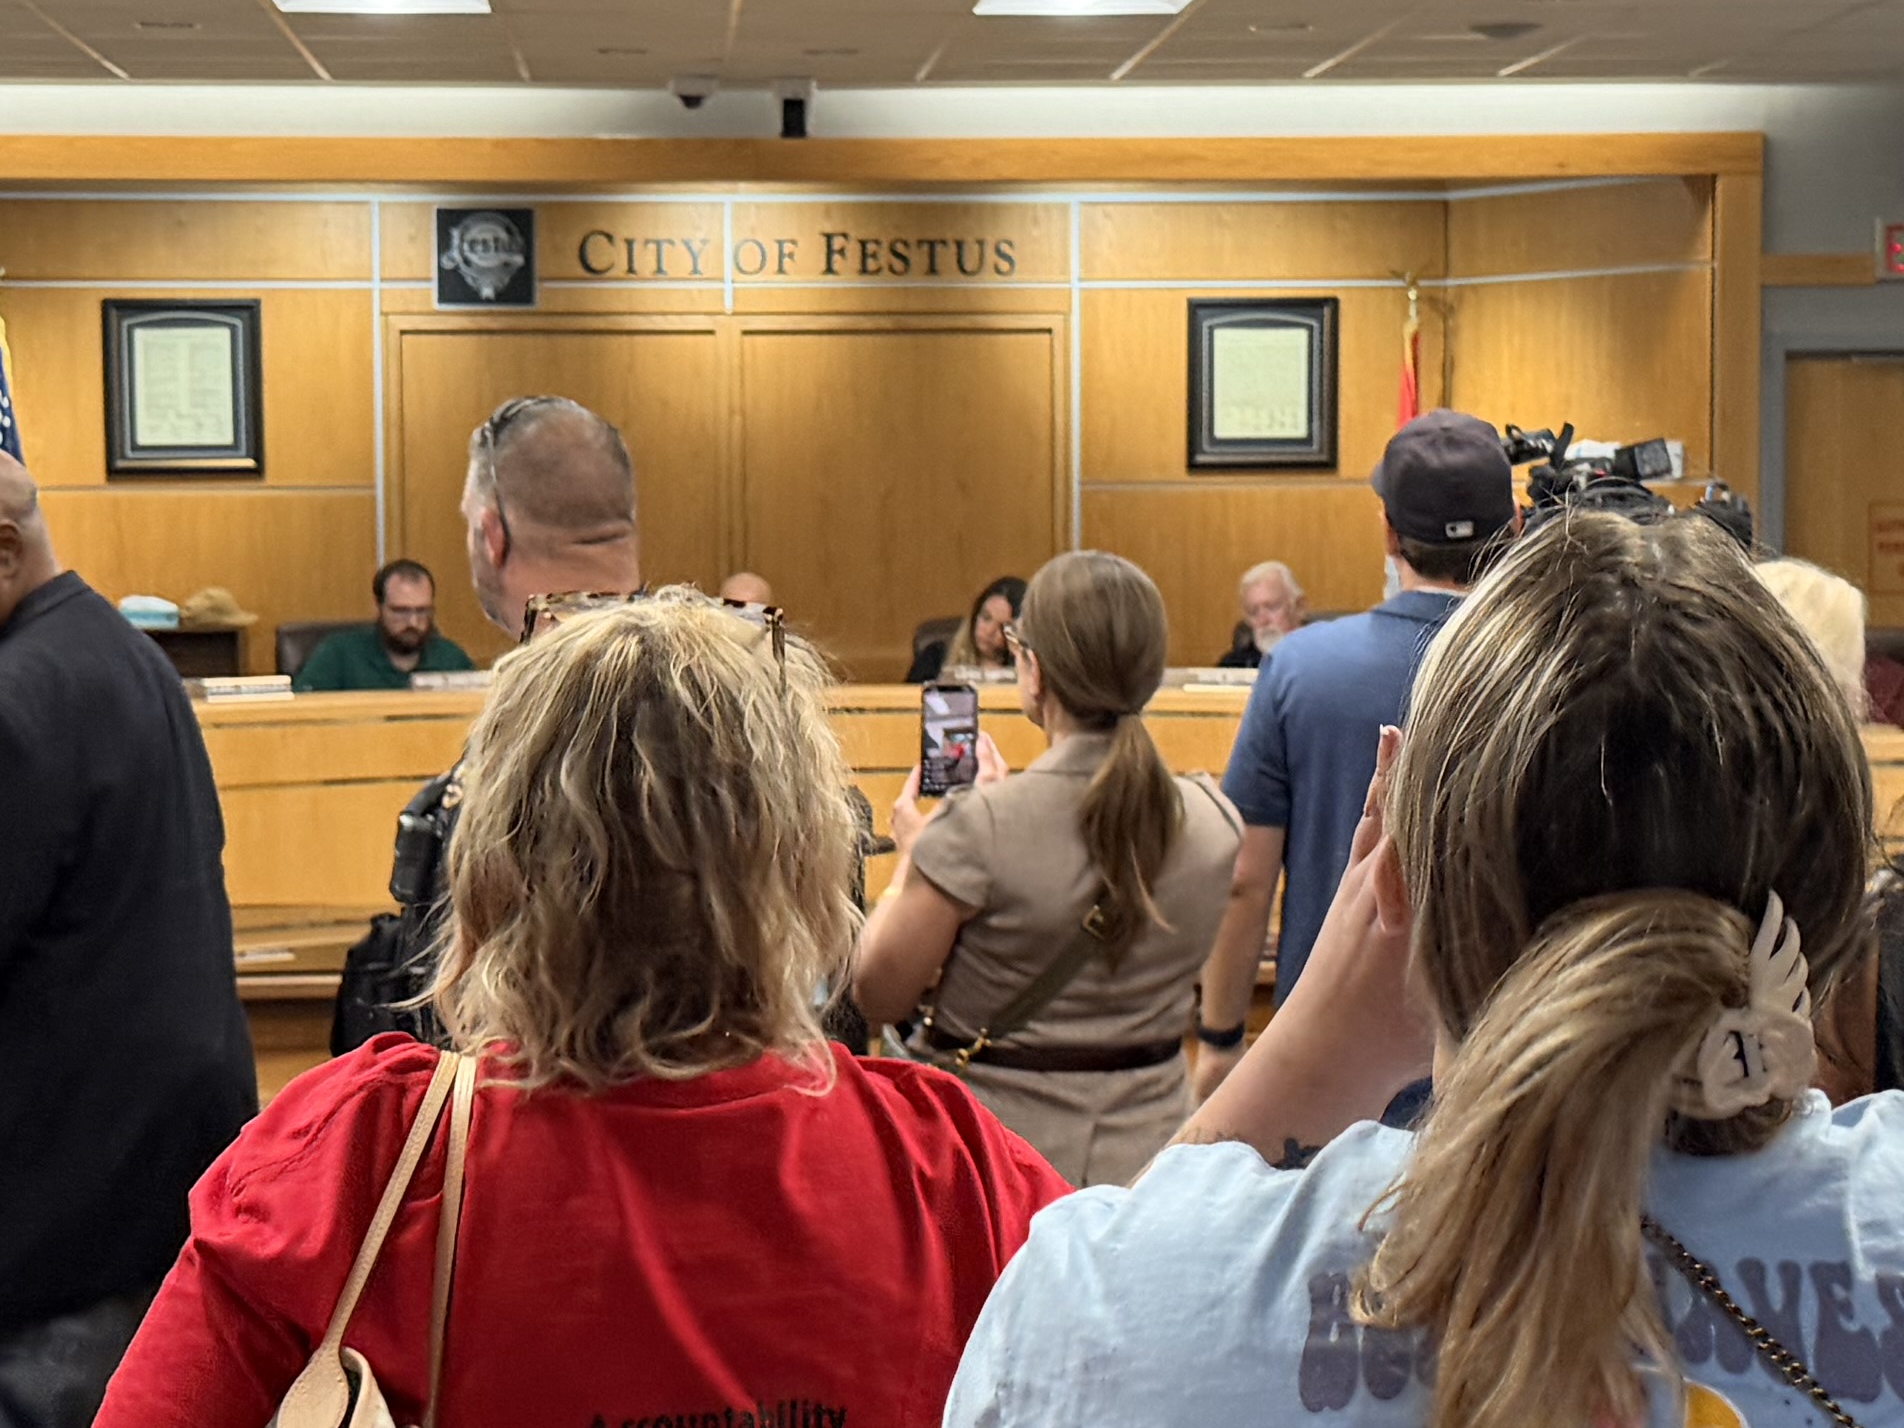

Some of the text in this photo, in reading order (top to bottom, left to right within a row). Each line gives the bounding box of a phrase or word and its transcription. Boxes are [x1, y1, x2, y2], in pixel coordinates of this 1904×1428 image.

[577, 230, 709, 277] CITY
[734, 238, 798, 276] OF
[821, 232, 1016, 277] FESTUS
